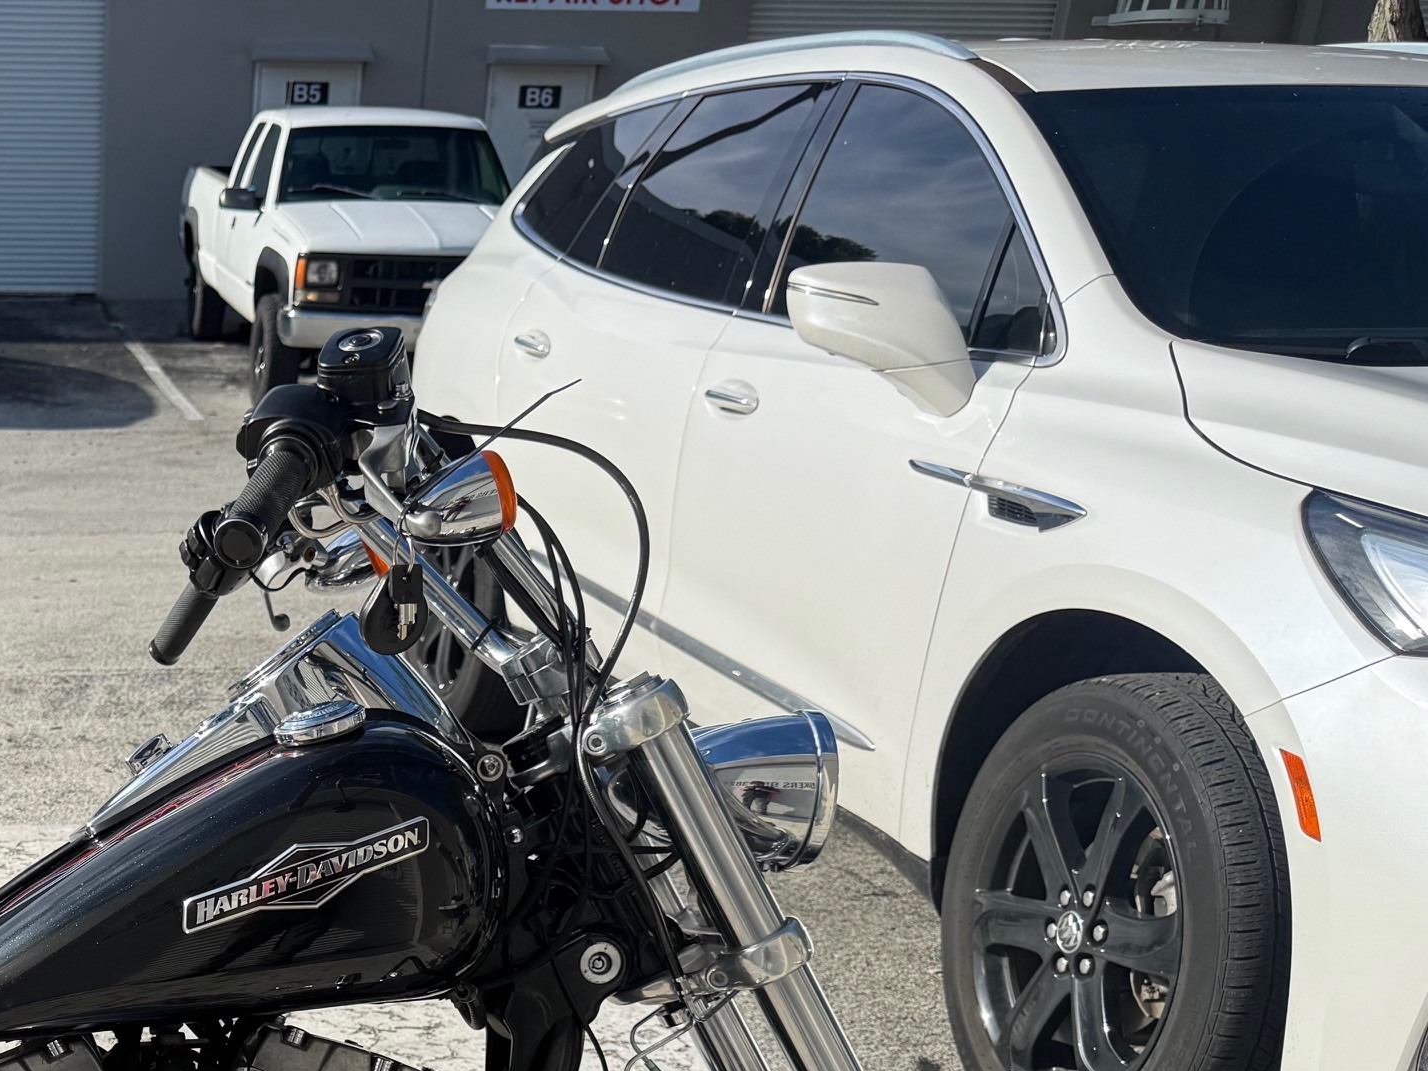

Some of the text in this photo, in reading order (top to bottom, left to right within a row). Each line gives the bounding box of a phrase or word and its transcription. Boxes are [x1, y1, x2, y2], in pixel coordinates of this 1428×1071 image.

[293, 84, 322, 103] B5
[525, 88, 554, 107] B6
[1064, 708, 1198, 864] CONTINENTAL
[196, 828, 420, 925] HARLEY-DAVIDSON
